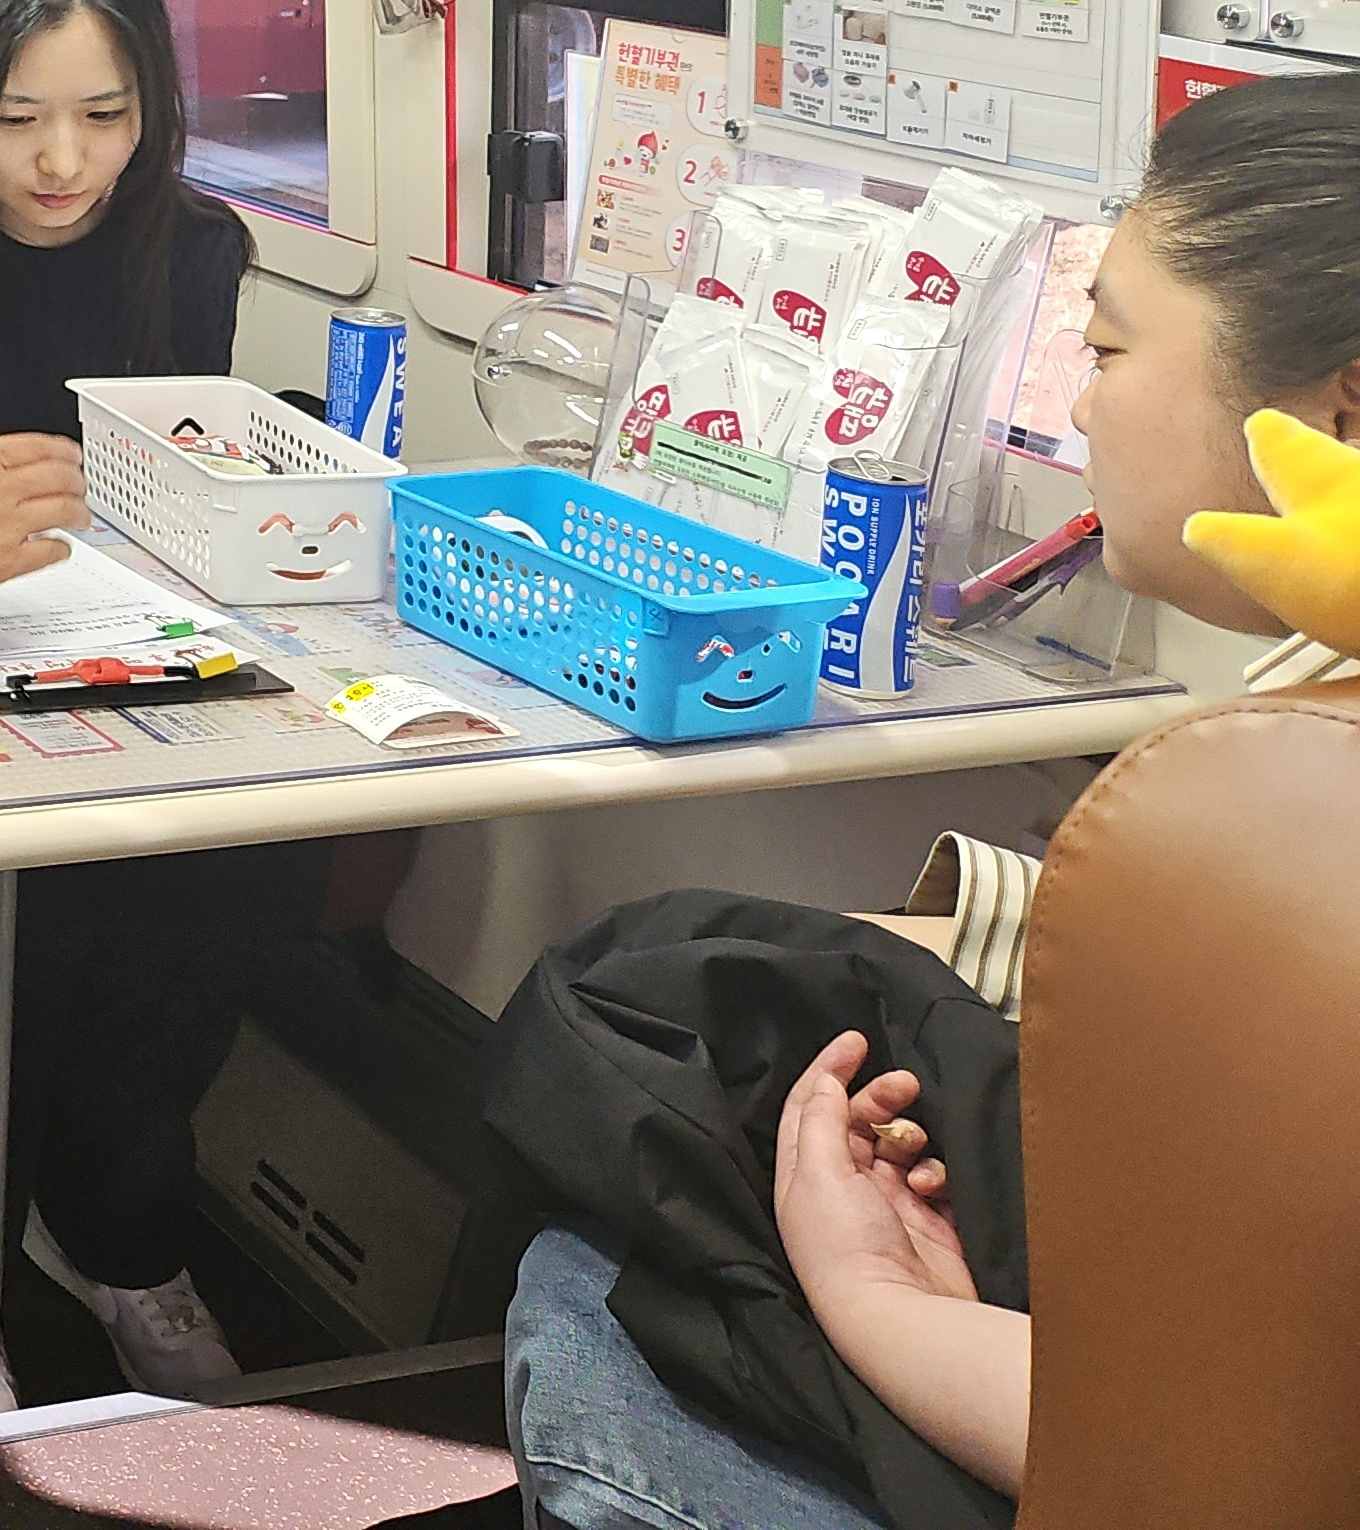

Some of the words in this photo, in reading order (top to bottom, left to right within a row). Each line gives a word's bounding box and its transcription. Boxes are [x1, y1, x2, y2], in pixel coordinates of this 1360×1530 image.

[615, 66, 651, 90] 특별한
[1184, 79, 1228, 99] 헌혈
[698, 91, 706, 114] 1
[683, 160, 697, 184] 2
[672, 228, 685, 252] 3
[871, 497, 880, 515] ION
[868, 515, 880, 549] SUPPLY
[866, 548, 877, 575] DRINK
